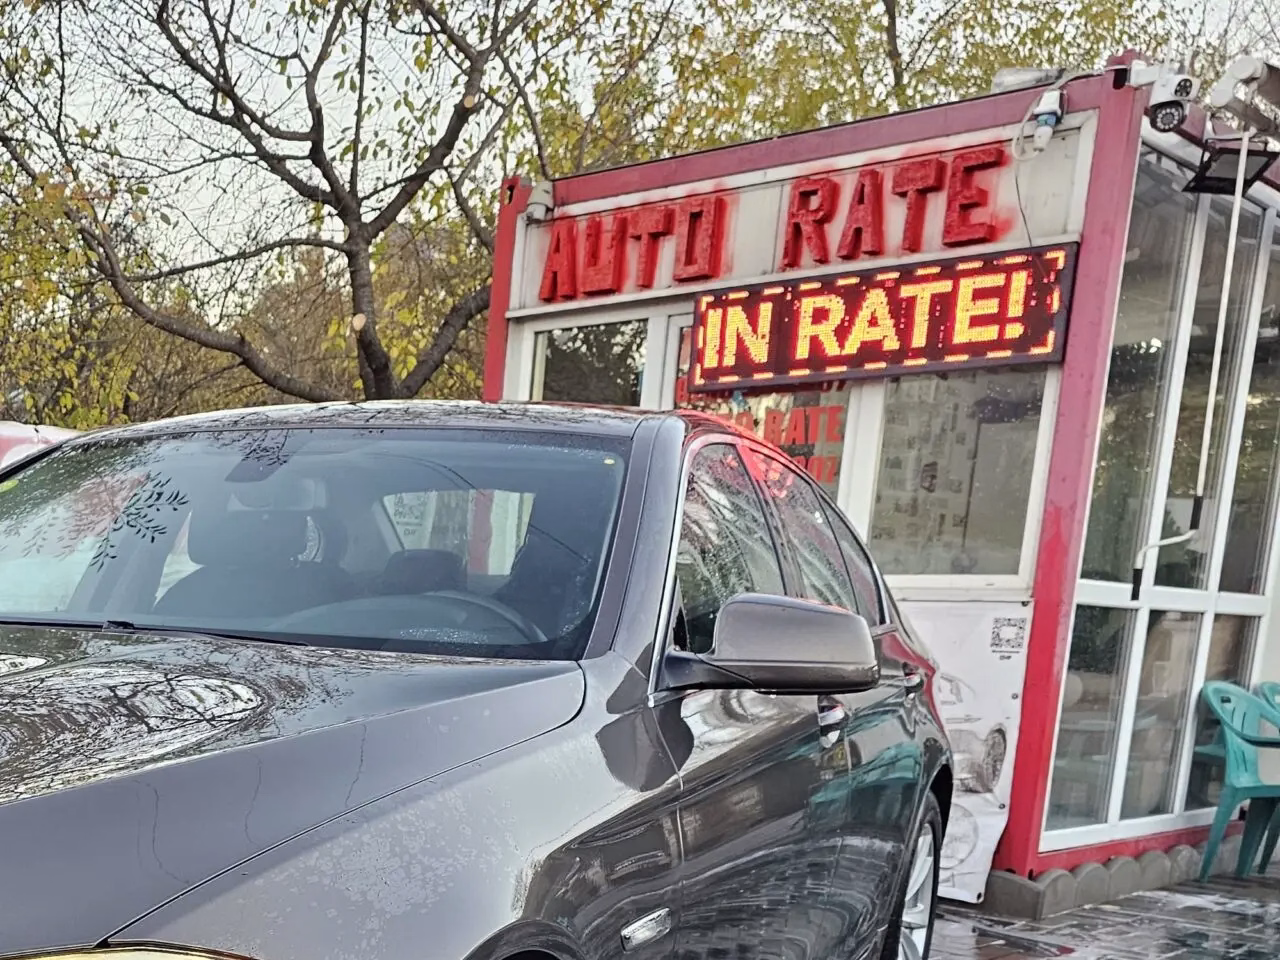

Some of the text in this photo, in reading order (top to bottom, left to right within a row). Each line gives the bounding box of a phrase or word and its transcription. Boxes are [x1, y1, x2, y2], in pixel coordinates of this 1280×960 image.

[539, 146, 1005, 302] AUTO RATE
[702, 268, 1028, 370] IN RATE!
